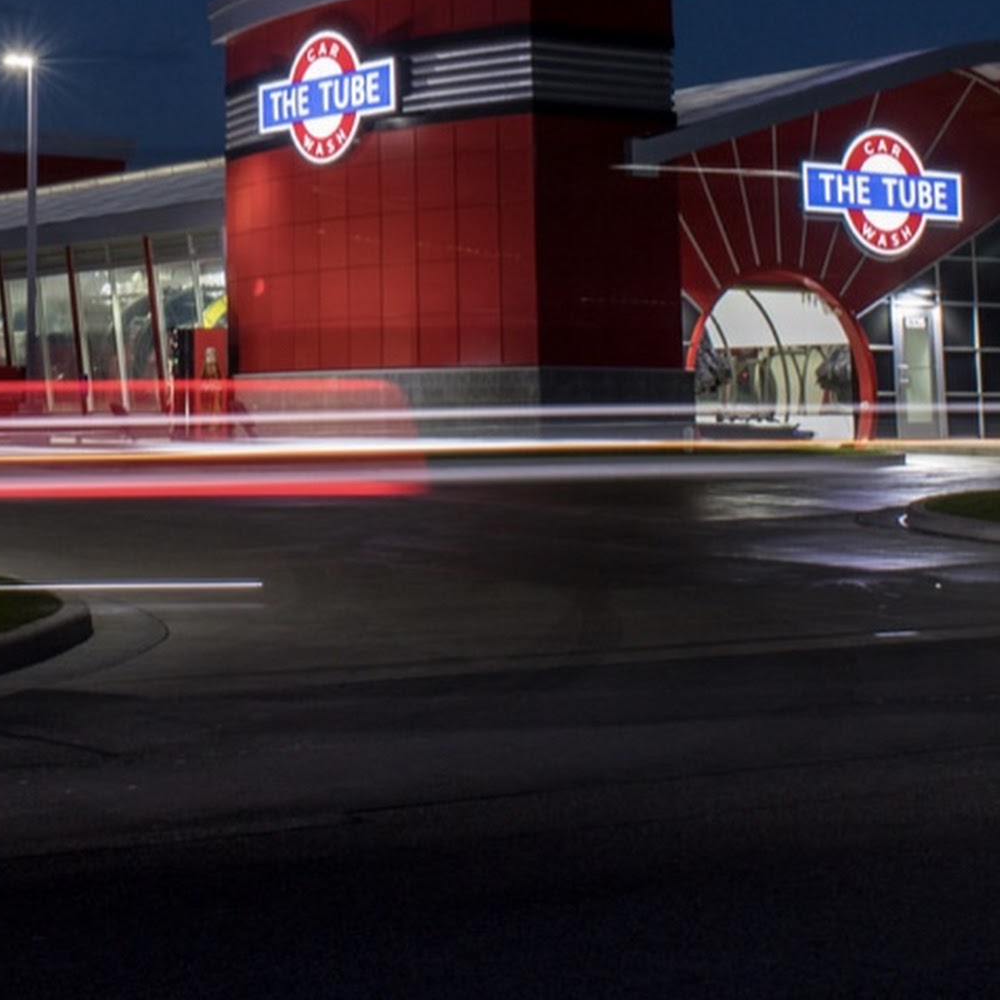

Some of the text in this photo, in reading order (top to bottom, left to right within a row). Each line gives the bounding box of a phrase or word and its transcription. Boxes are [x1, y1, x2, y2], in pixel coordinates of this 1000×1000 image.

[306, 42, 340, 62] CAR
[270, 71, 380, 121] THE TUBE
[303, 128, 347, 155] WASH
[863, 139, 902, 158] CAR
[818, 172, 948, 211] THE TUBE
[862, 223, 912, 247] WASH
